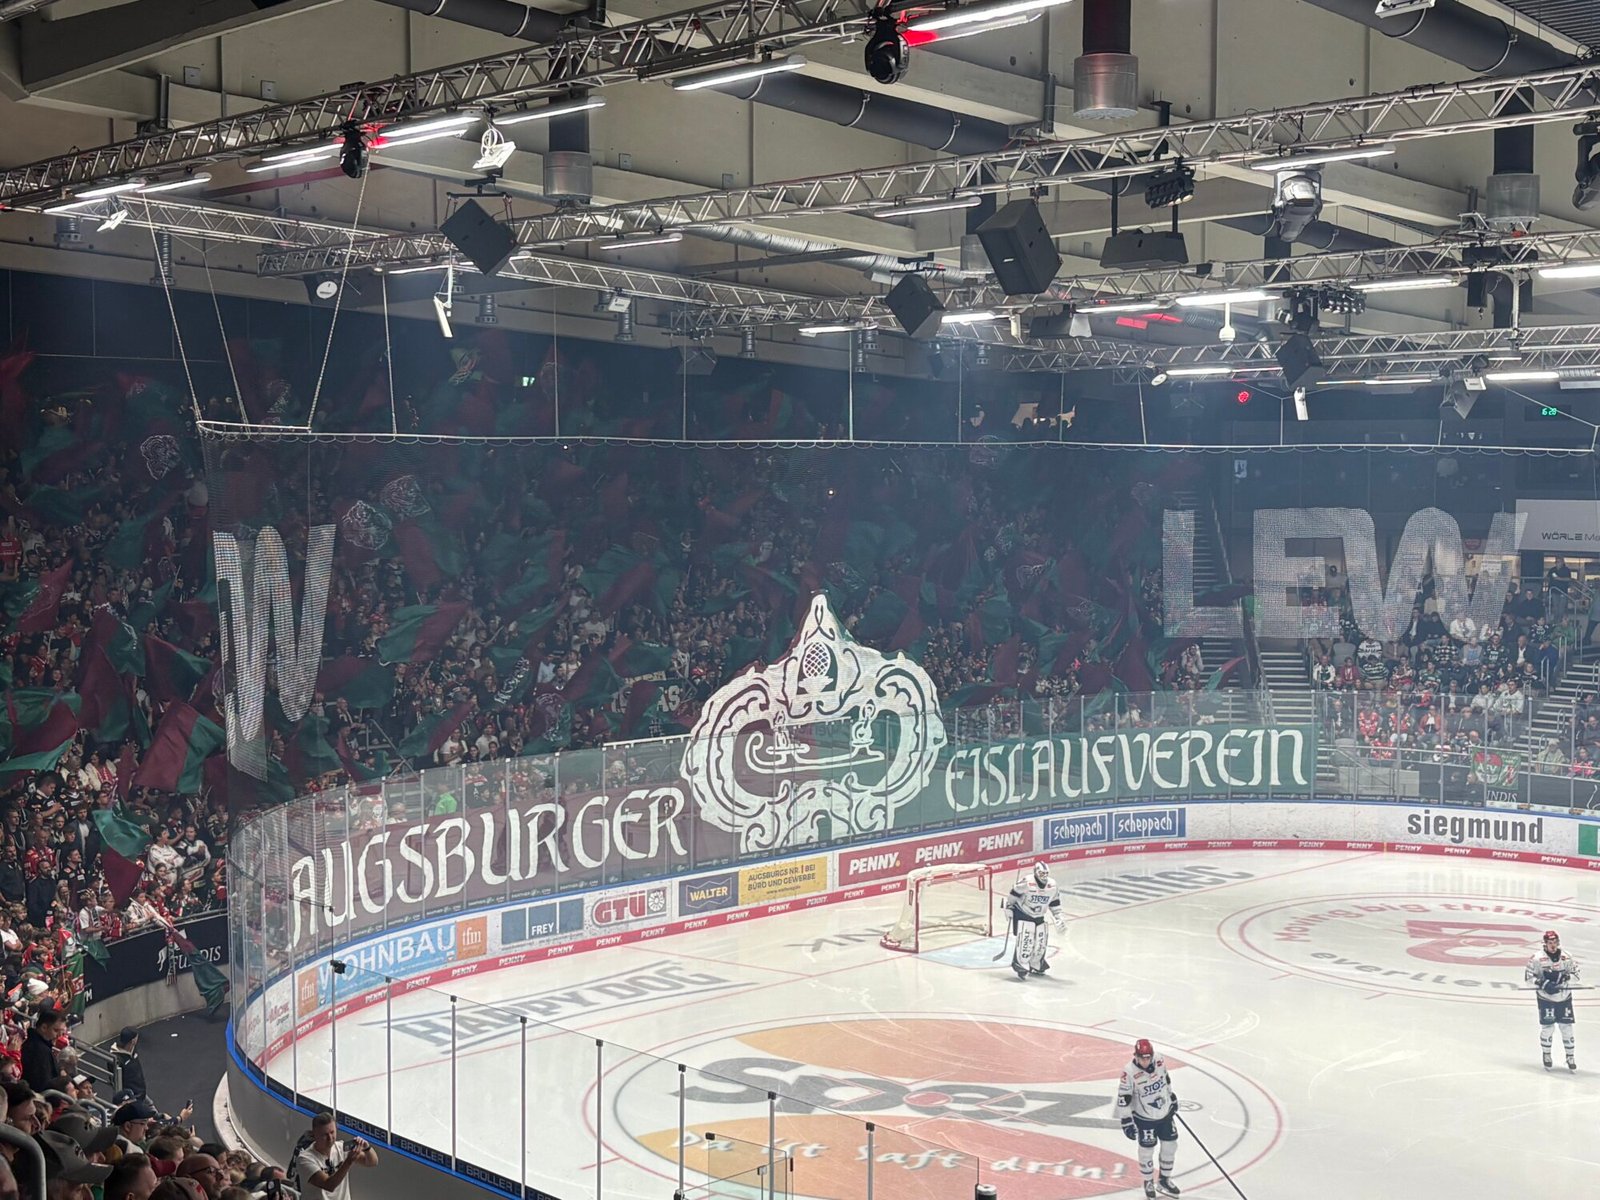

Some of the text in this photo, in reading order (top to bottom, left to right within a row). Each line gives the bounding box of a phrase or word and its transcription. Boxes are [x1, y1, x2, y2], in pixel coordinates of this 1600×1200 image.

[945, 729, 1309, 812] EISLAUFVEREIN
[1053, 815, 1102, 844] scheppach
[1118, 810, 1172, 837] scheppach
[1407, 809, 1543, 843] siegmund
[287, 787, 689, 951] AUGSBURGER
[594, 890, 646, 924] GTÜ
[690, 886, 728, 902] WALTER
[531, 922, 554, 936] FREY
[1273, 902, 1591, 943] Moving big things
[319, 925, 456, 991] WOHNBAU
[389, 962, 731, 1048] HAPPY DOG
